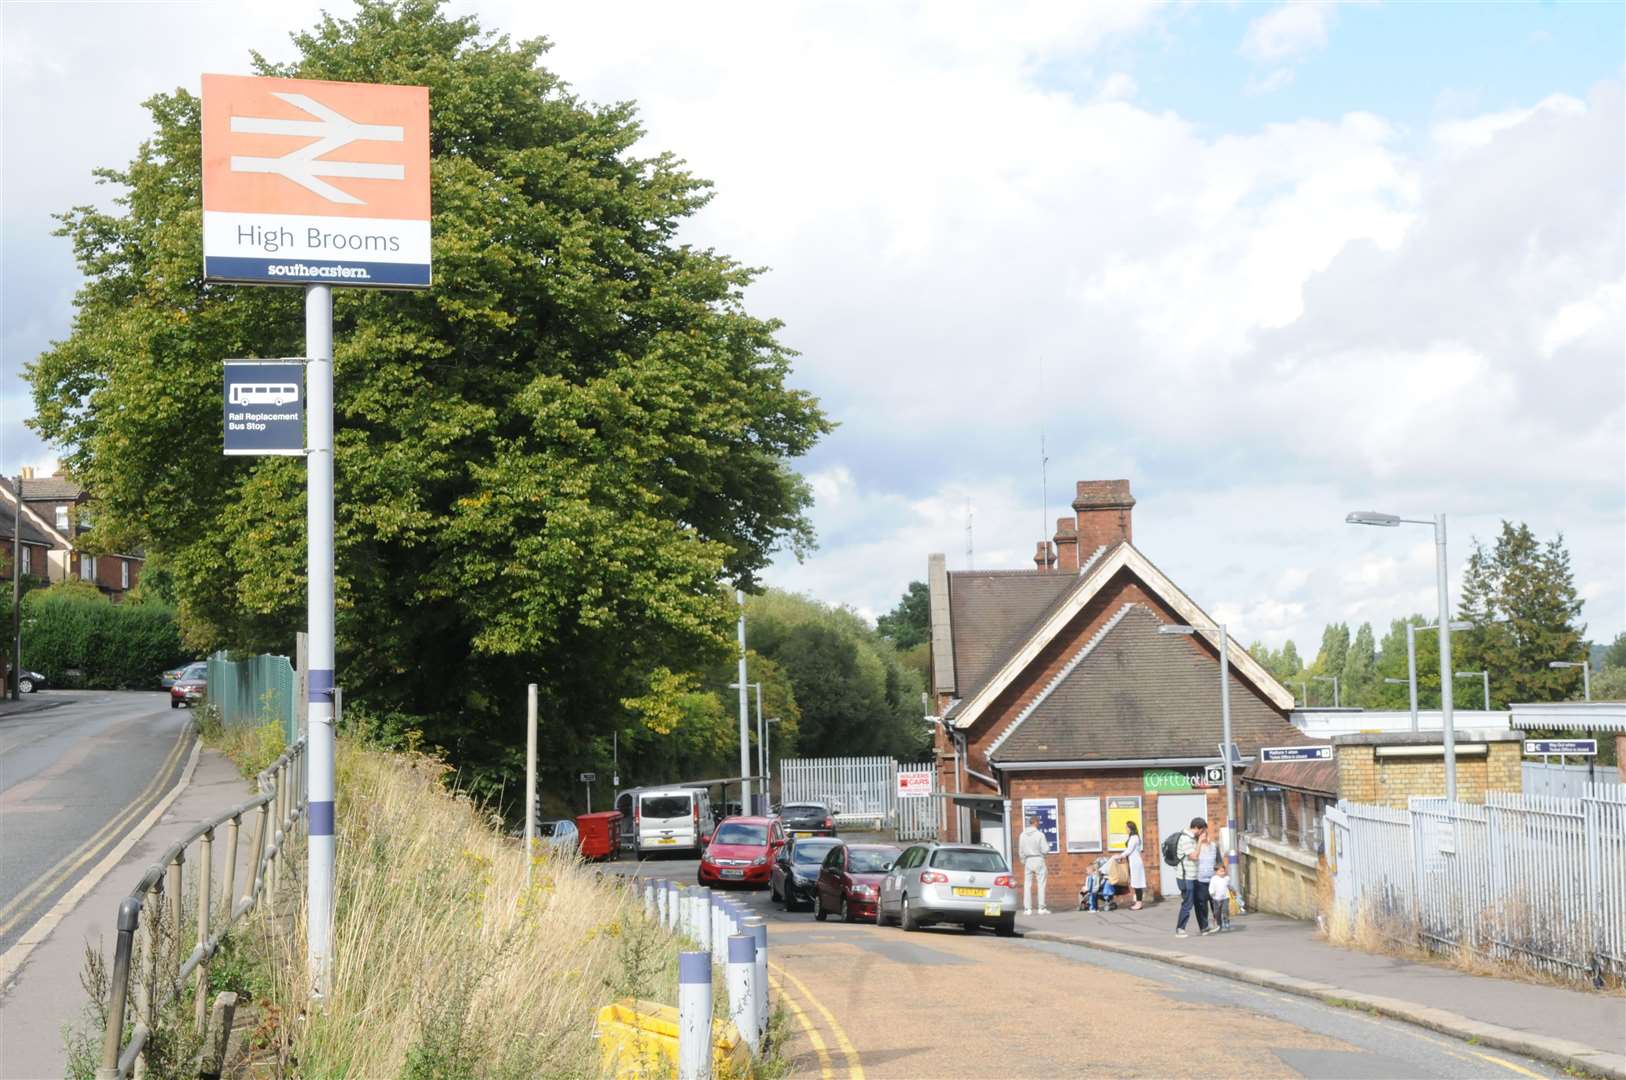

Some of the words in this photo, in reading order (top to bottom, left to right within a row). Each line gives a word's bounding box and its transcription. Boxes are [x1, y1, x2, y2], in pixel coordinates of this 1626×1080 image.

[238, 225, 293, 252] High
[307, 227, 400, 252] Brooms
[245, 413, 298, 421] Replacement
[246, 423, 266, 431] Stop
